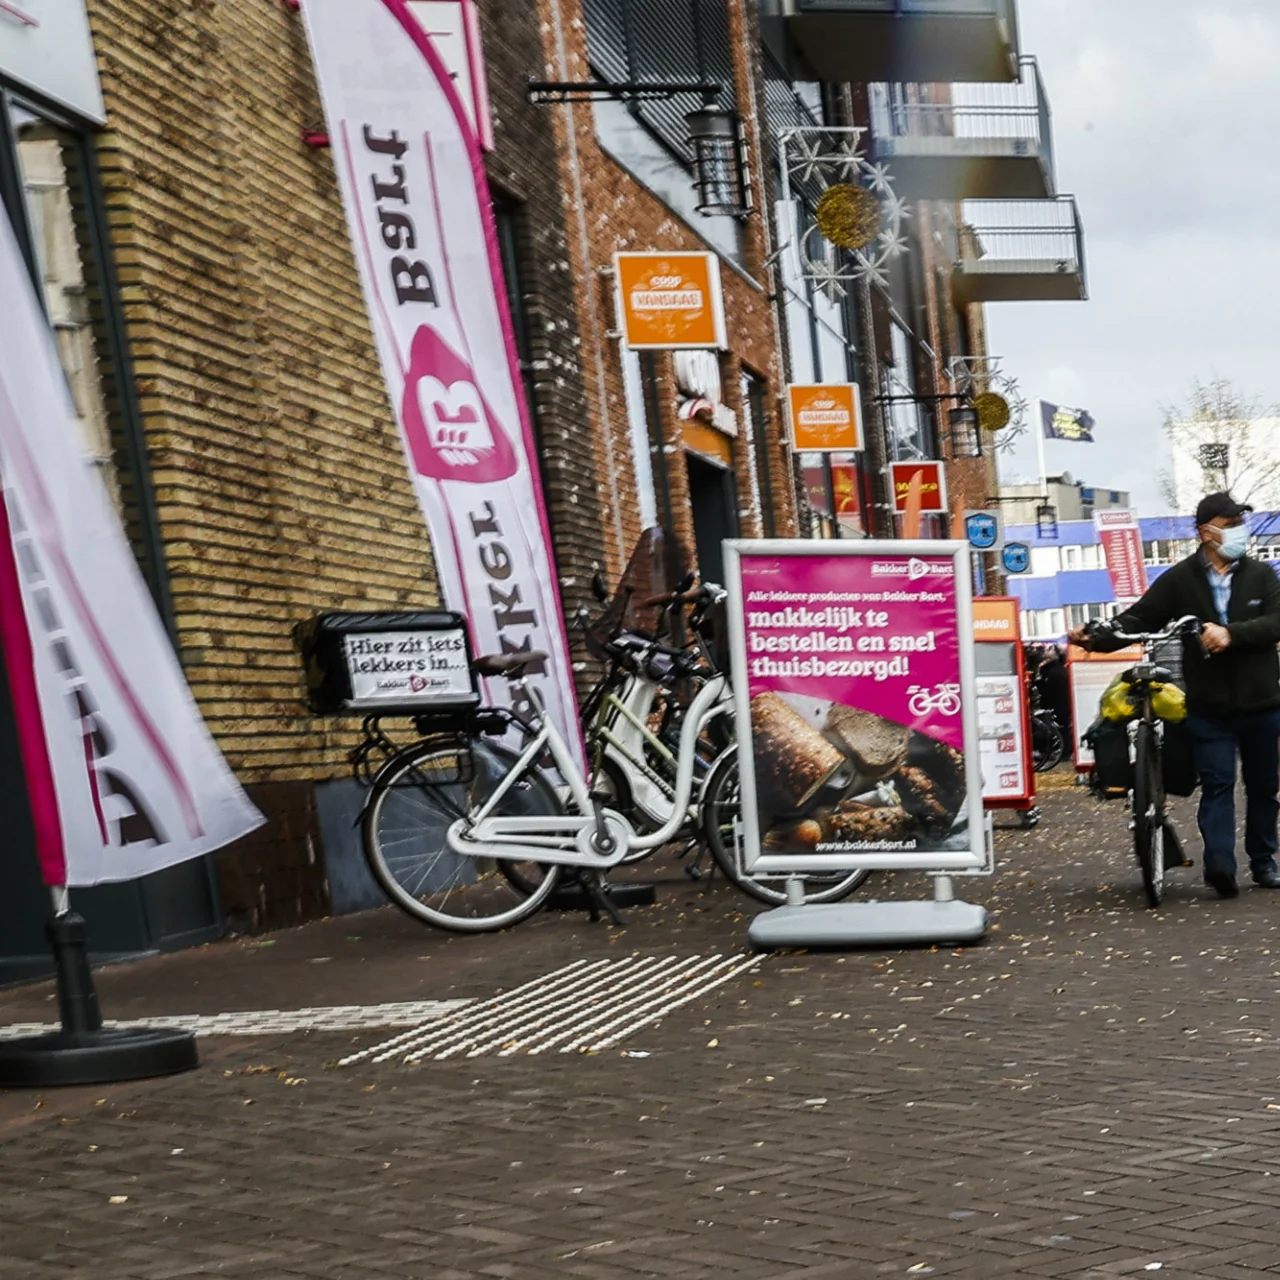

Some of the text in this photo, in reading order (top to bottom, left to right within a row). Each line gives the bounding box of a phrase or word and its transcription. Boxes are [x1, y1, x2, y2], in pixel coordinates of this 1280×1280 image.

[363, 124, 440, 309] Bart
[635, 292, 699, 306] VANDAAG
[808, 592, 861, 604] producten
[863, 593, 881, 603] van
[748, 607, 889, 632] makkelijk te
[350, 636, 464, 655] Hier zit iets
[750, 631, 936, 652] bestellen en snel
[352, 657, 426, 673] lekkers
[752, 656, 910, 681] thuisbezorgd!
[815, 839, 917, 852] www.bakkerbart.nl
